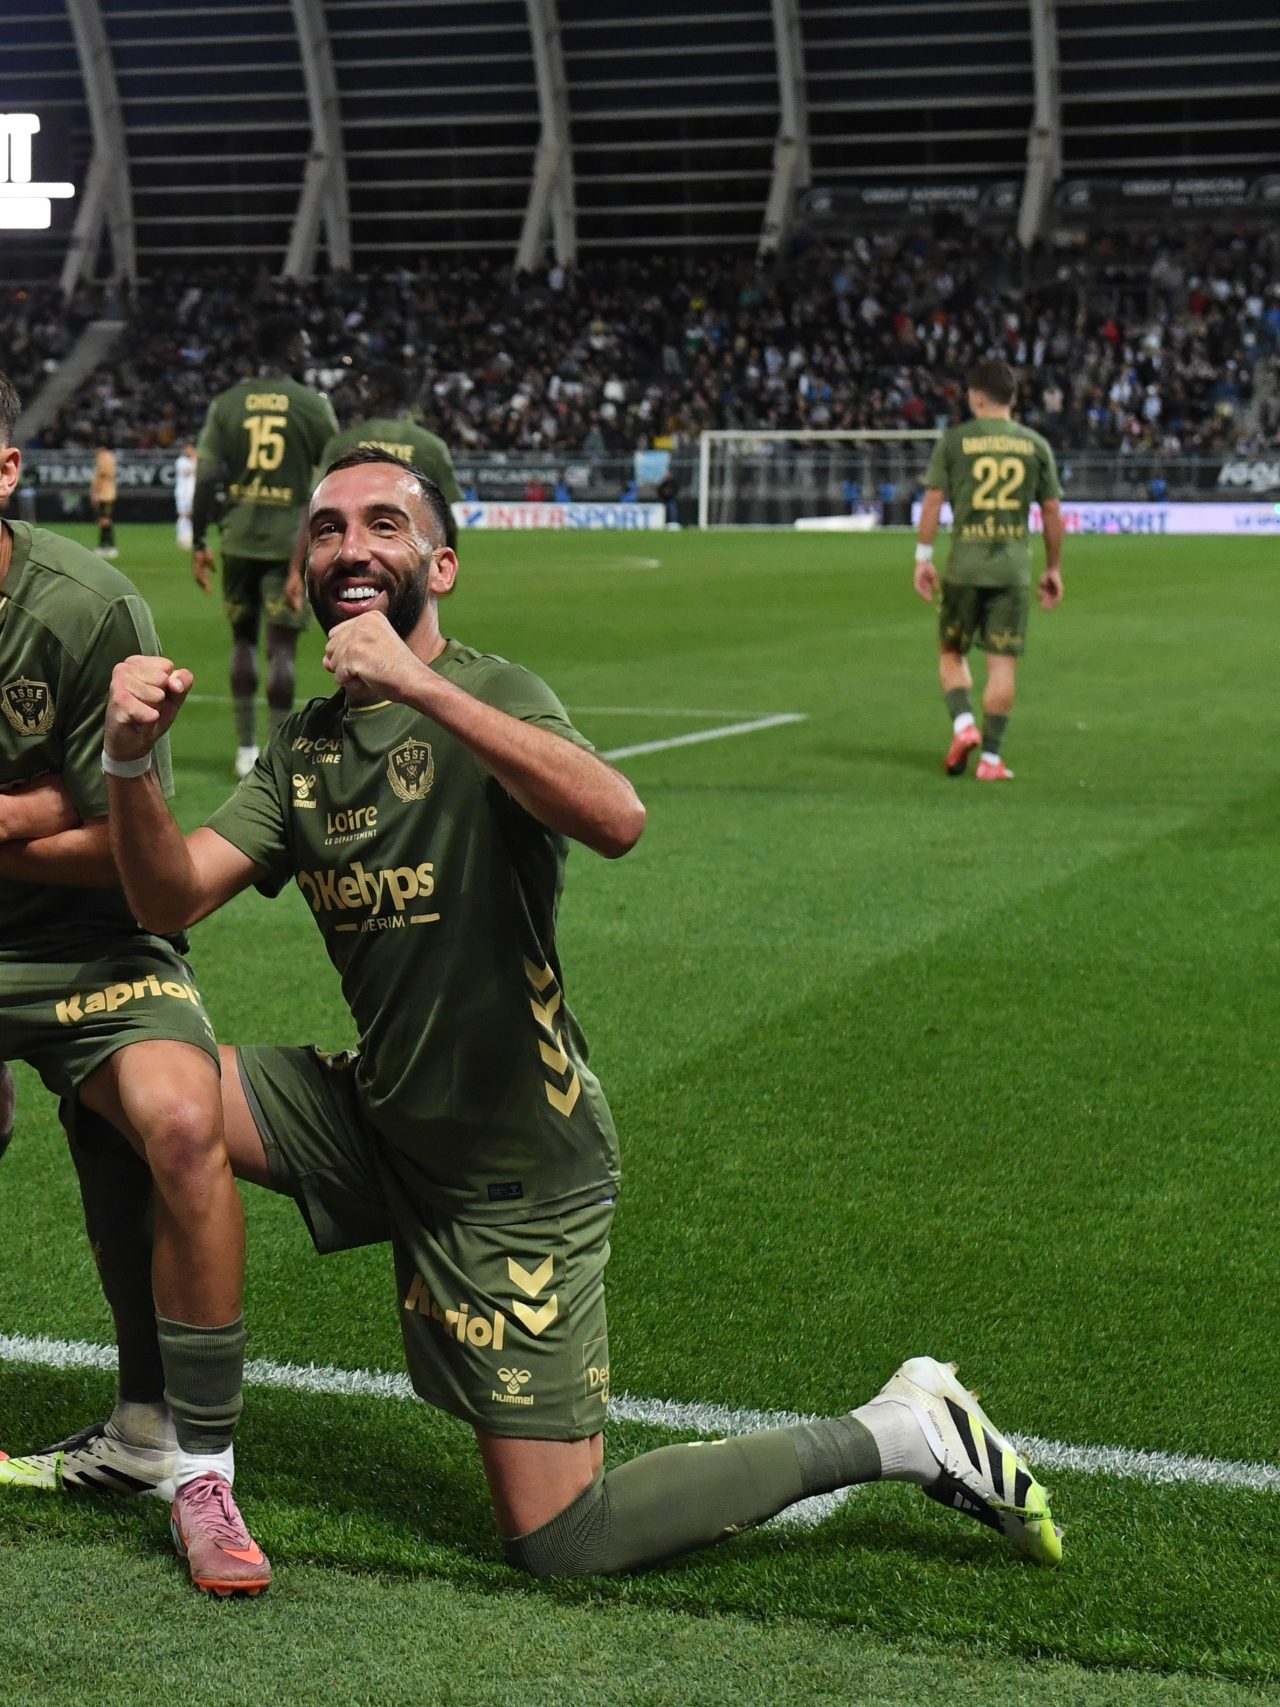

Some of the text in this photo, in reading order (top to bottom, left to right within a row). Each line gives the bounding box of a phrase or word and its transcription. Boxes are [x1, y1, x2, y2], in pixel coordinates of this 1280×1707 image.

[242, 415, 288, 472] 15
[971, 455, 1026, 511] 22
[487, 508, 651, 530] INTERSPORT
[10, 688, 43, 700] ASSE
[312, 753, 342, 765] LOIRE
[395, 749, 426, 766] ASSE
[327, 805, 378, 835] Loire
[324, 829, 378, 846] LE DÉPARTEMENT
[314, 861, 435, 915] Kelyps
[491, 1390, 534, 1406] hummel
